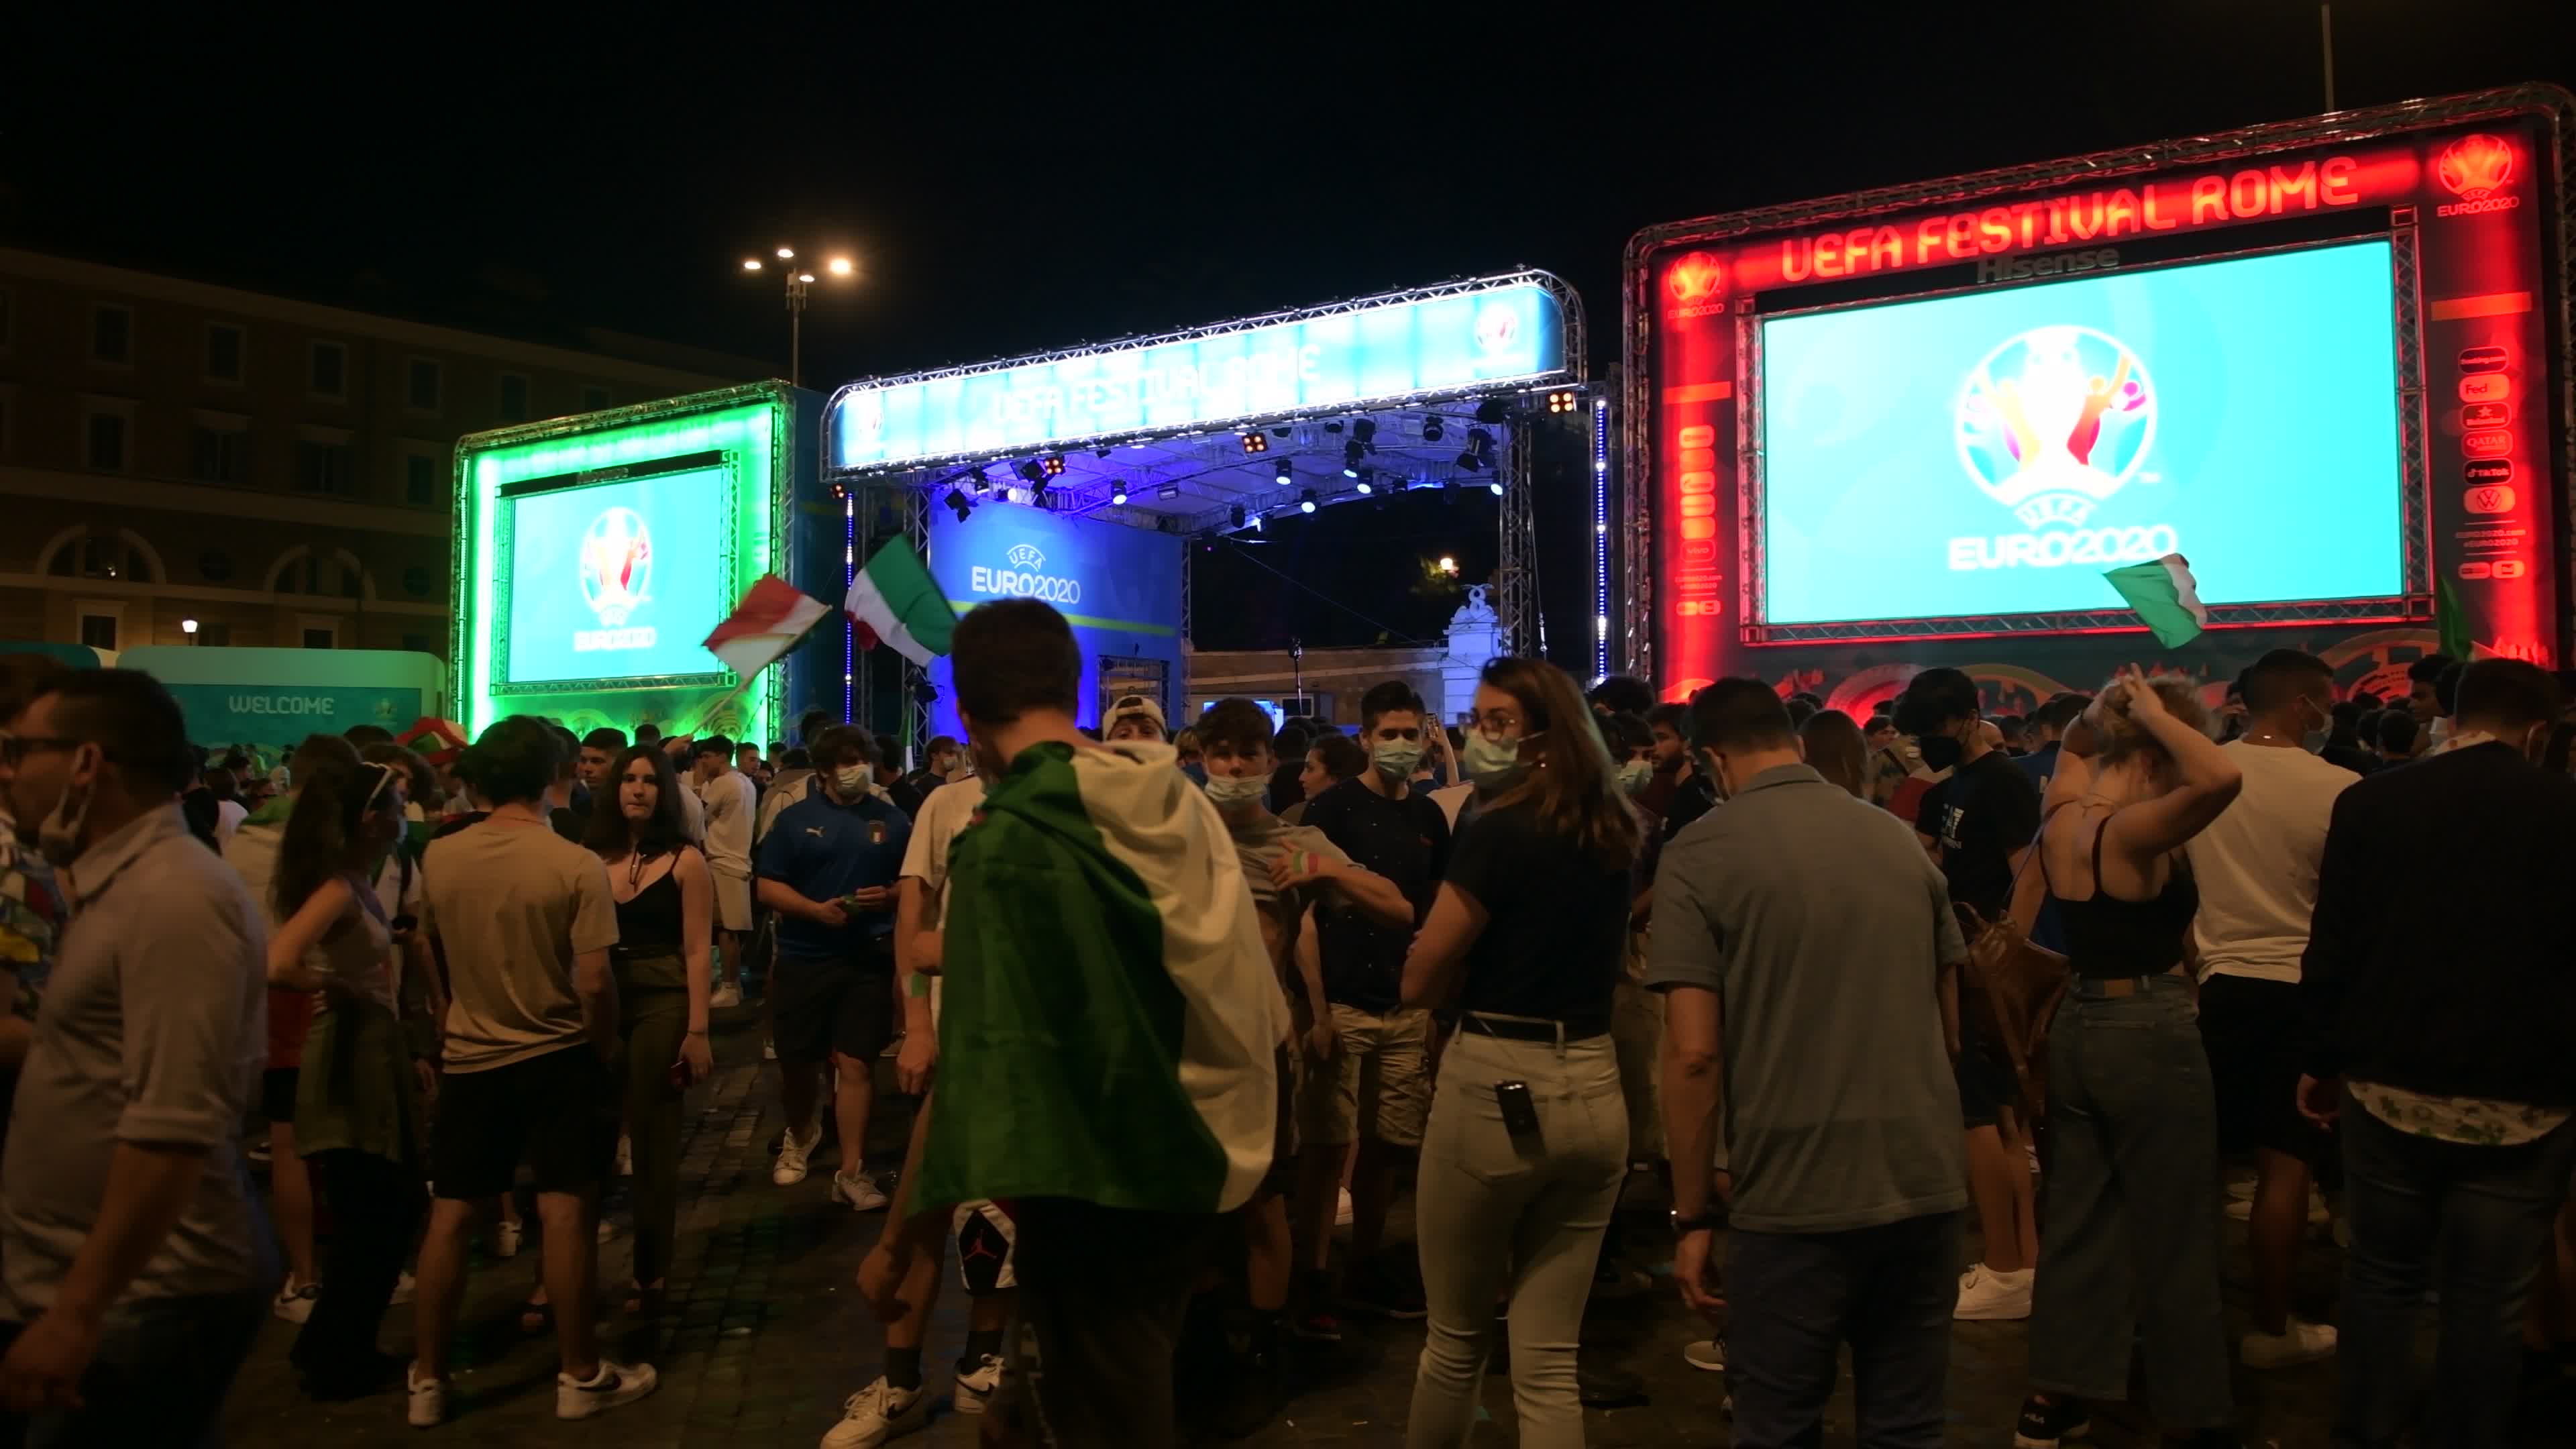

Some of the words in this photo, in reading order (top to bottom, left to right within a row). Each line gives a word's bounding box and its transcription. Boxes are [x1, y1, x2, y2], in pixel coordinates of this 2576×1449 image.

[1782, 225, 1902, 281] UEFA
[1917, 184, 2176, 264] FESTIVAL
[2192, 156, 2359, 224] ROME
[2437, 196, 2520, 217] EURO2020
[1977, 248, 2121, 284] Hisense
[1008, 547, 1042, 570] UEFA
[1948, 525, 2178, 570] EURO2020
[971, 566, 1081, 604] EURO2020
[229, 695, 335, 715] WELCOME
